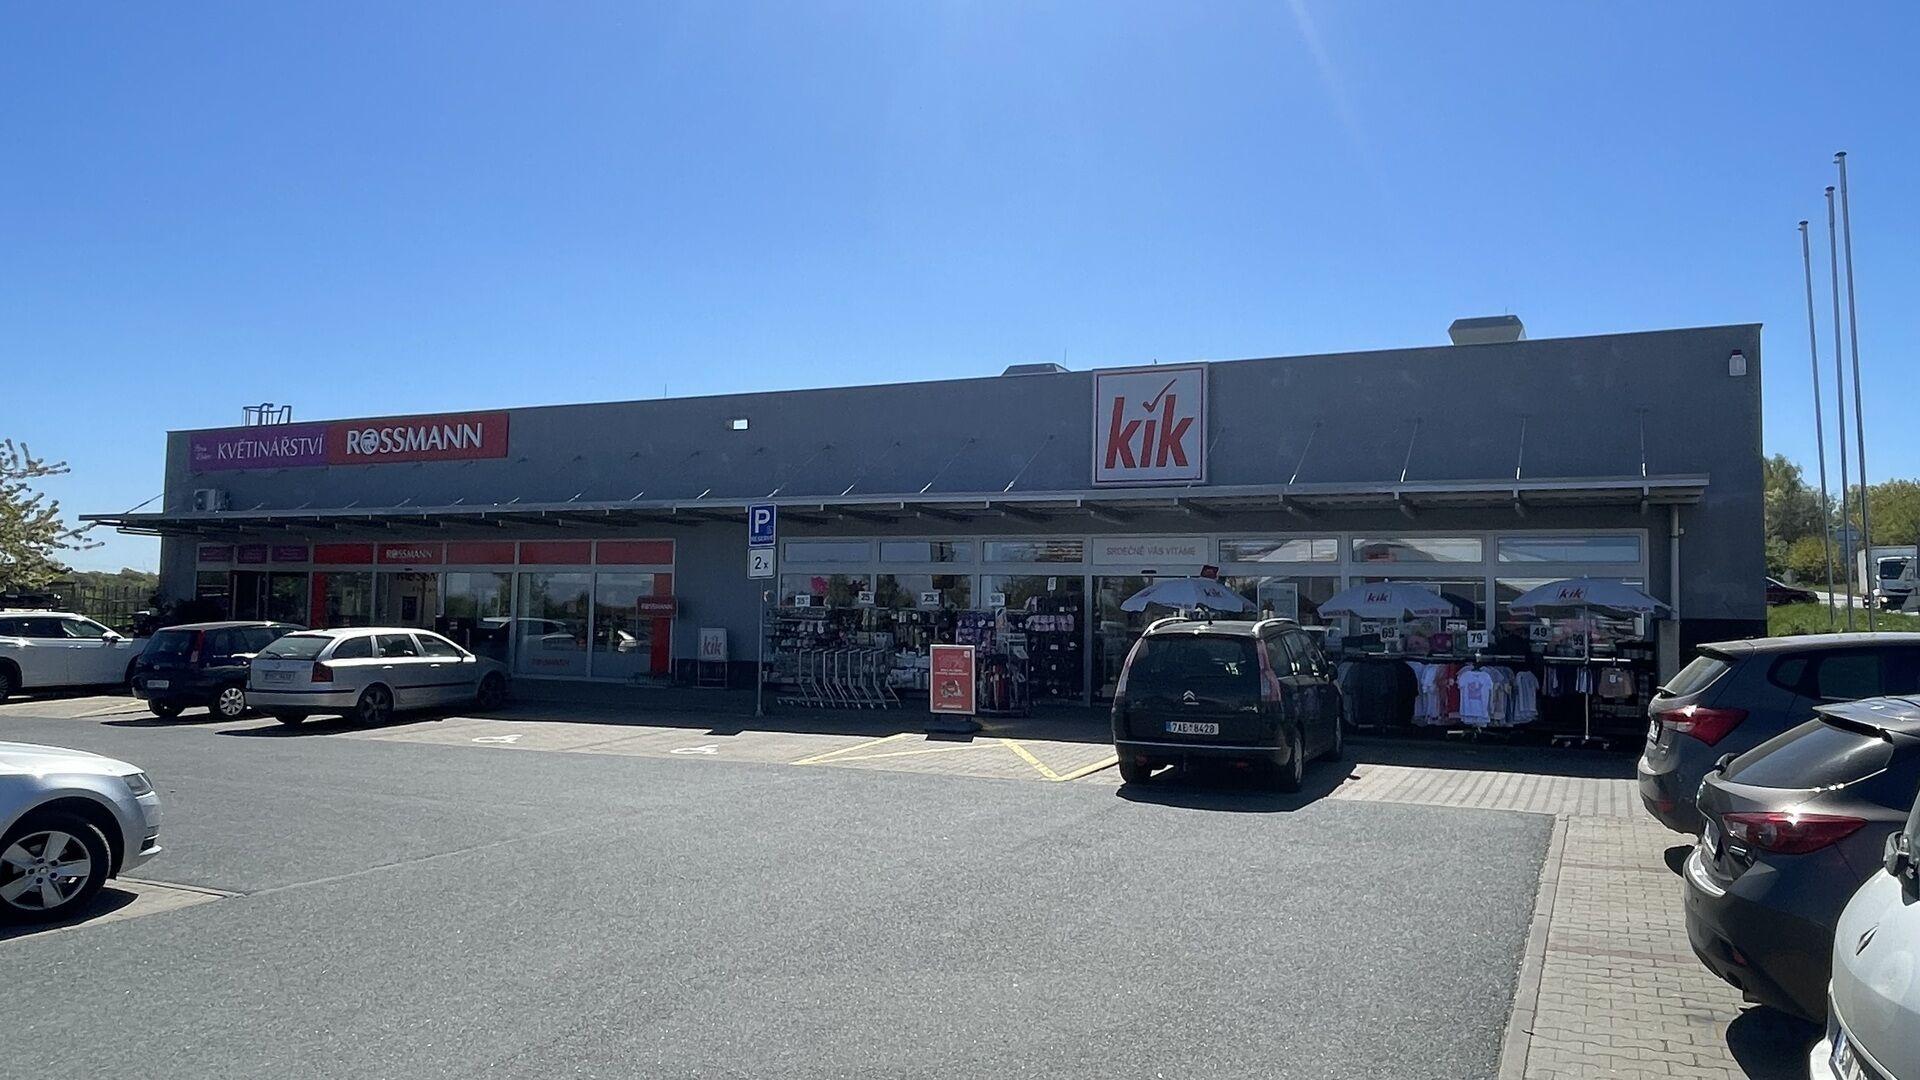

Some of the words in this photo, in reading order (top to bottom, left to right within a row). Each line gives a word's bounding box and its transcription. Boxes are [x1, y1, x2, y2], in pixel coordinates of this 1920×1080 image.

[1105, 378, 1194, 469] kik
[217, 433, 324, 460] KVĚTINÁŘSTVÍ
[346, 423, 483, 455] ROSSMANN
[755, 509, 771, 534] P
[386, 549, 432, 559] ROSSMANN
[1367, 592, 1389, 602] kik
[1559, 587, 1585, 599] kik
[1471, 633, 1483, 643] 79
[1532, 627, 1548, 638] 49
[702, 634, 723, 656] kik
